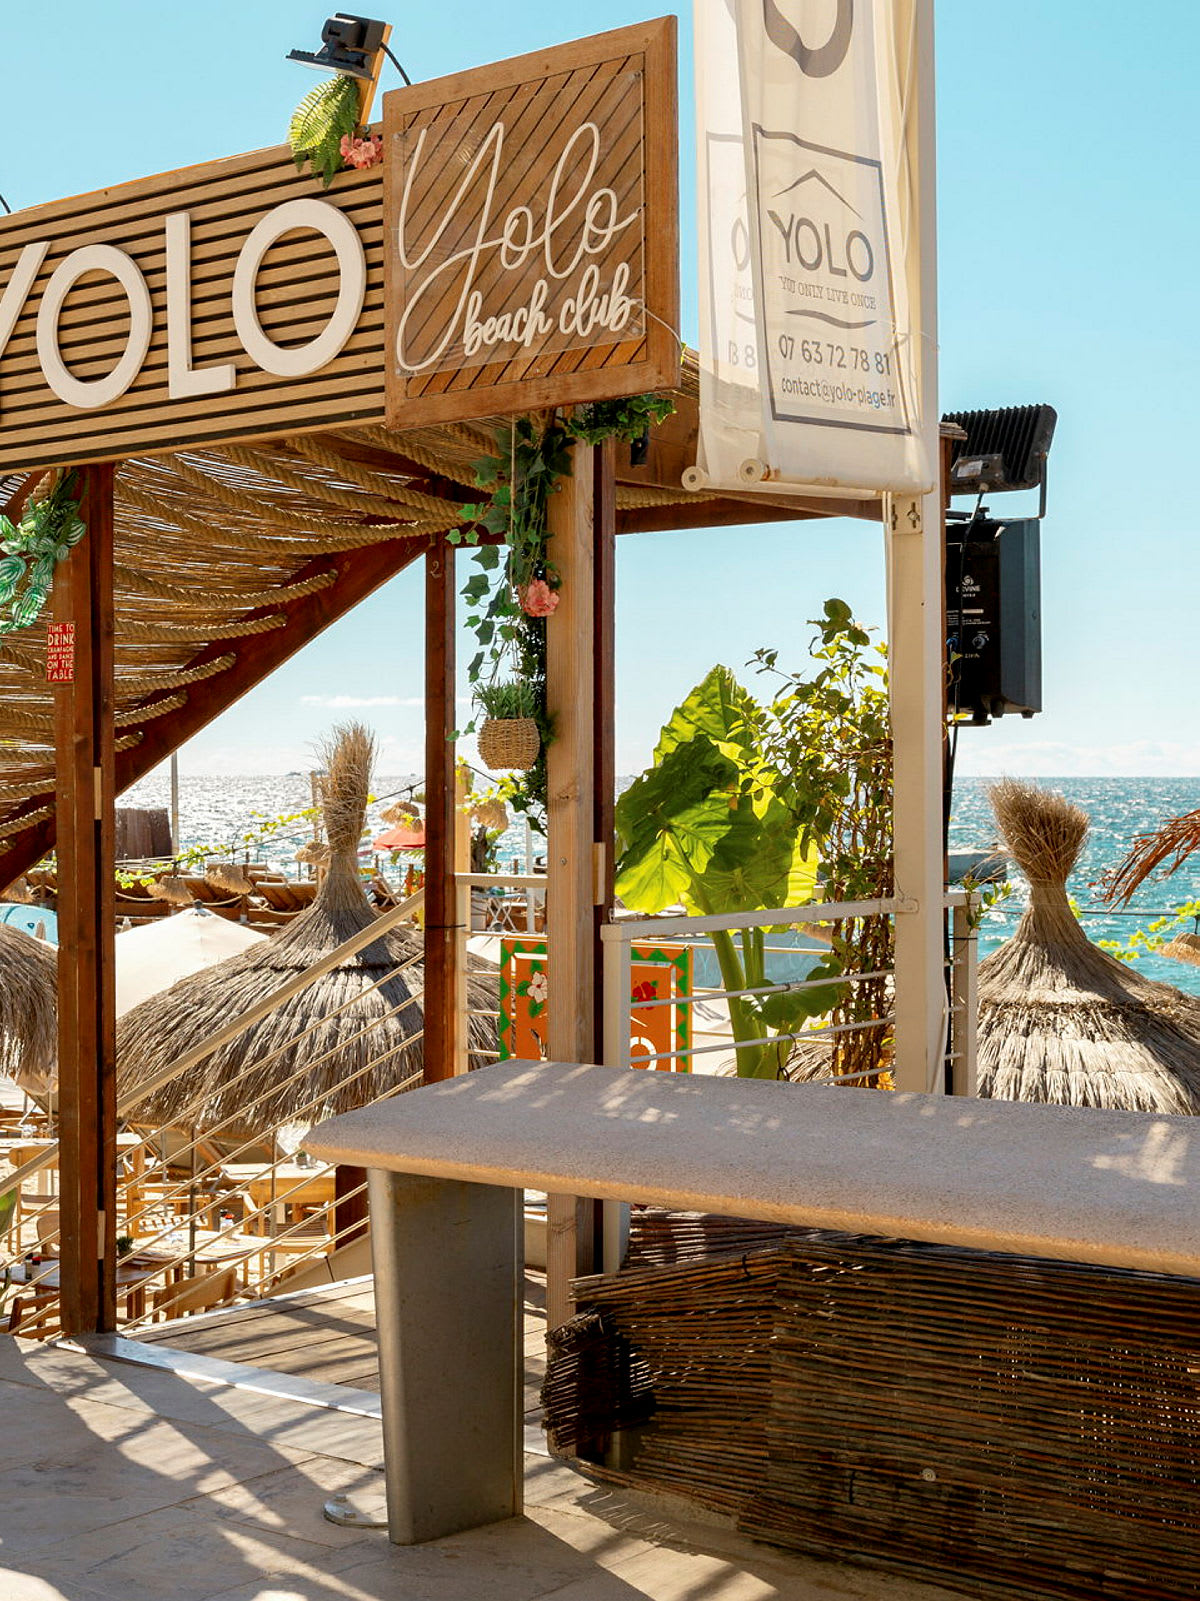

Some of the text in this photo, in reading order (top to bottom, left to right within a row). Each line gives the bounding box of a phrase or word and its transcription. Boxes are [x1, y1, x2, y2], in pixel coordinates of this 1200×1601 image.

[398, 121, 640, 371] Yolo
[767, 209, 874, 282] YOLO
[463, 262, 632, 357] beach club
[797, 282, 825, 299] ONLY
[825, 287, 850, 305] LIVE
[851, 292, 877, 311] ONCE
[778, 334, 795, 361] 07
[801, 339, 824, 365] 63
[827, 343, 847, 369] 72
[850, 347, 871, 373] 78
[875, 351, 892, 377] 81
[780, 376, 896, 408] contact@yolo-plage.fr
[47, 633, 75, 646] DRINK
[65, 623, 75, 632] TO
[46, 659, 74, 669] ON THE
[47, 668, 75, 680] TABLE
